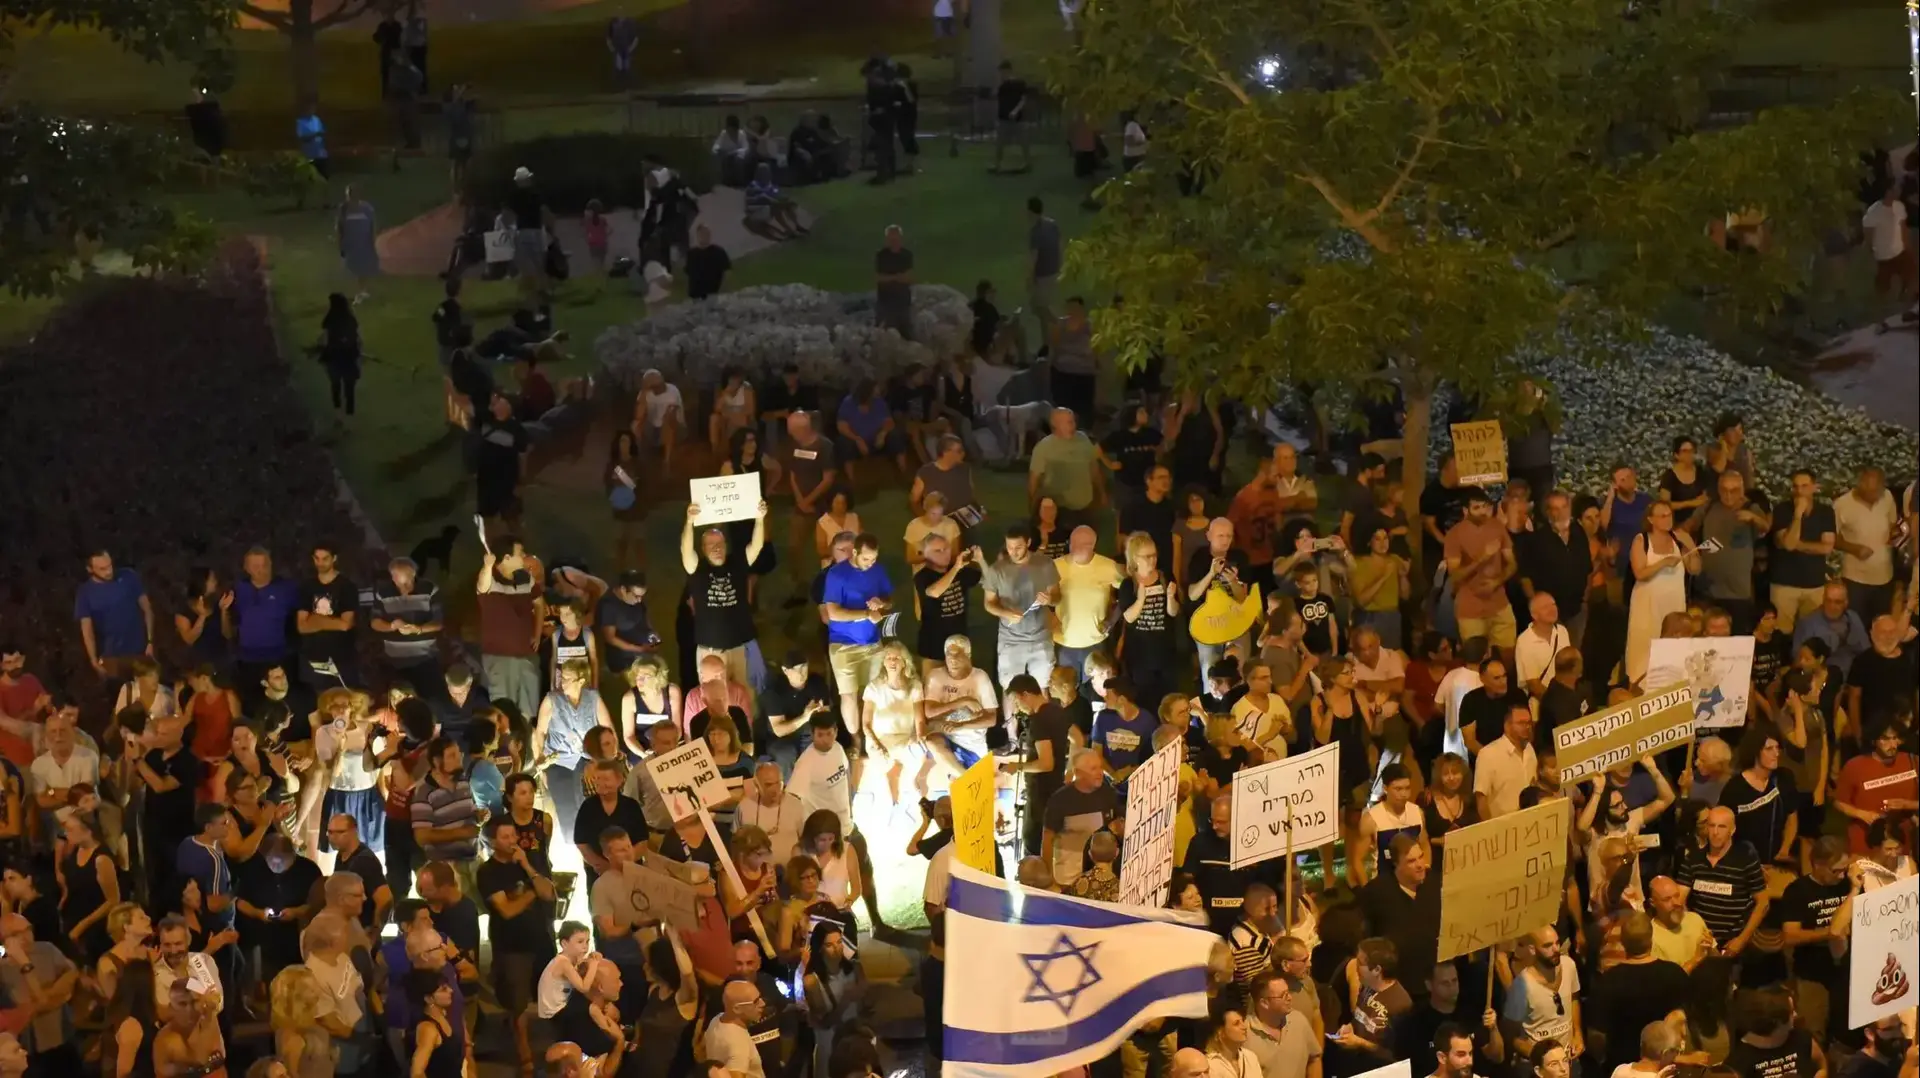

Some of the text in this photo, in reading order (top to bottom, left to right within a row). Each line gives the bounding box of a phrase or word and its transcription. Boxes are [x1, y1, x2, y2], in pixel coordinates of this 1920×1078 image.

[705, 494, 717, 504] על
[1560, 688, 1692, 748] העננים מתקבצים
[694, 759, 708, 770] עד
[1562, 722, 1693, 782] והסופה מתקרבת
[656, 761, 670, 773] לנו
[693, 771, 715, 788] כאן
[1297, 763, 1325, 784] הדג
[1262, 788, 1314, 813] מסריח
[1268, 810, 1326, 836] מהראש
[1525, 851, 1554, 878] הם
[1486, 878, 1551, 912] עוכרי
[1449, 910, 1528, 949] ישראל
